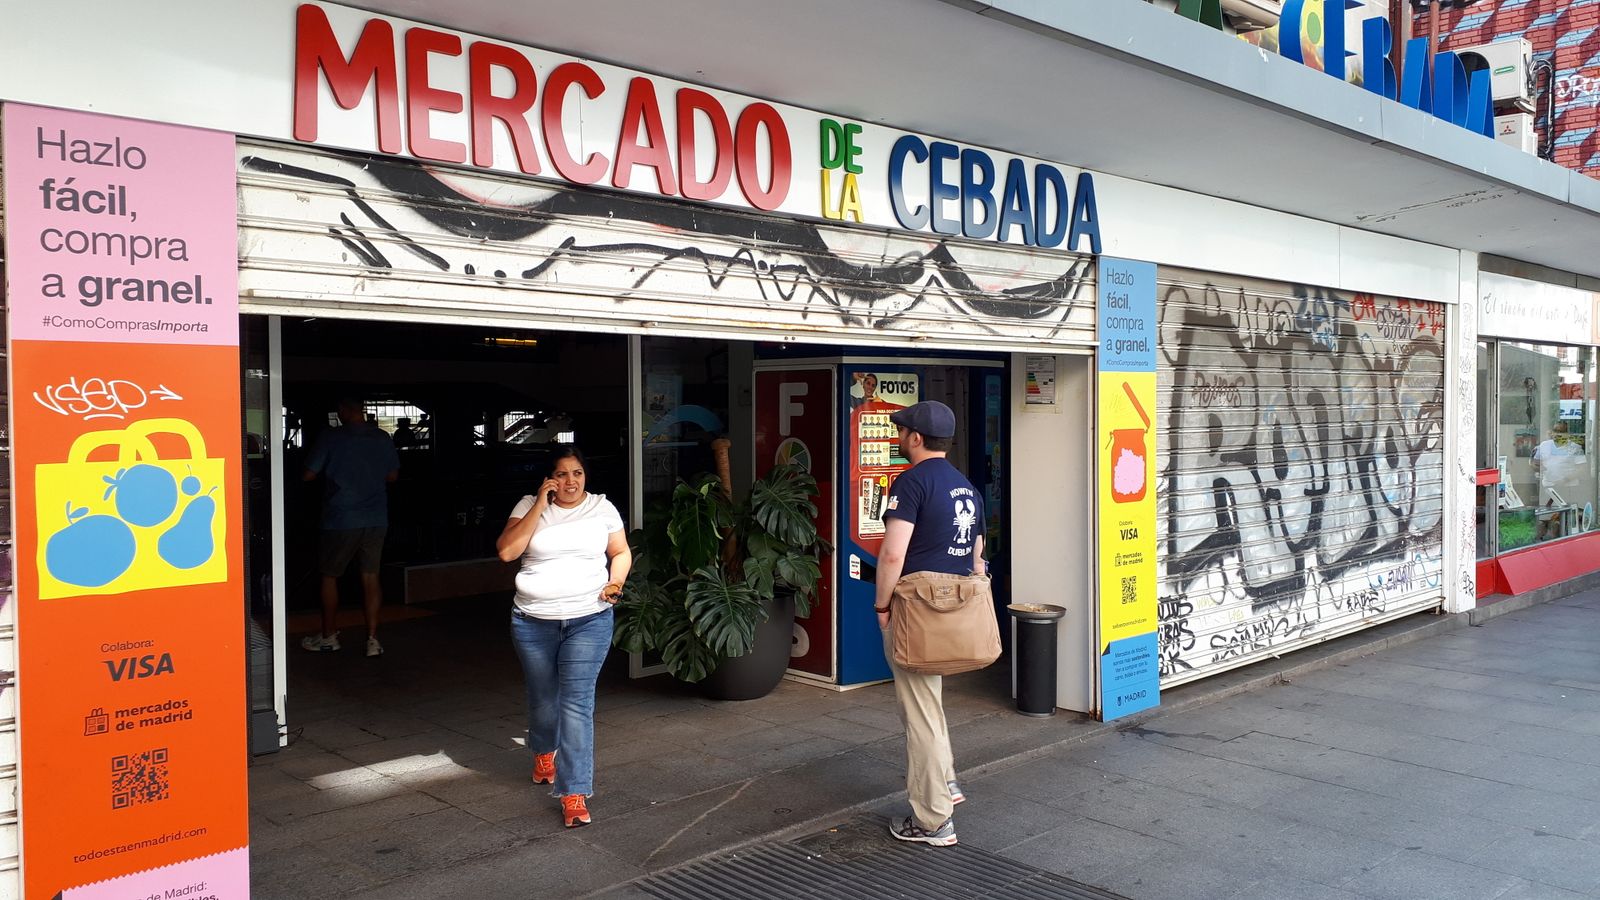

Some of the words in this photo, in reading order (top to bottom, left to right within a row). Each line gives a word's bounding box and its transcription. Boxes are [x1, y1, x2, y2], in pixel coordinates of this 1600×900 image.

[293, 3, 791, 211] MERCADO
[37, 126, 147, 170] Hazlo
[820, 118, 863, 174] DE
[39, 177, 137, 222] fácil,
[820, 169, 864, 223] LA
[888, 134, 1102, 254] CEBADA
[40, 228, 189, 265] compra
[1106, 267, 1134, 286] Hazlo
[41, 273, 66, 298] a
[78, 273, 212, 307] granel.
[1106, 291, 1131, 312] fácil,
[42, 315, 209, 333] #ComoComprasImporta
[1106, 315, 1144, 334] compra
[1106, 337, 1113, 351] a
[1115, 337, 1150, 355] granel.
[880, 381, 915, 394] FOTOS
[1120, 528, 1138, 541] VISA
[947, 546, 972, 557] DUBLIN
[100, 639, 155, 653] Colabora:
[101, 653, 175, 682] VISA
[1125, 690, 1147, 703] MADRID
[115, 699, 189, 718] mercados
[116, 720, 135, 732] de
[139, 709, 193, 728] madrid
[74, 826, 207, 864] todoestaenmadrid.com
[164, 882, 207, 900] Madrid:
